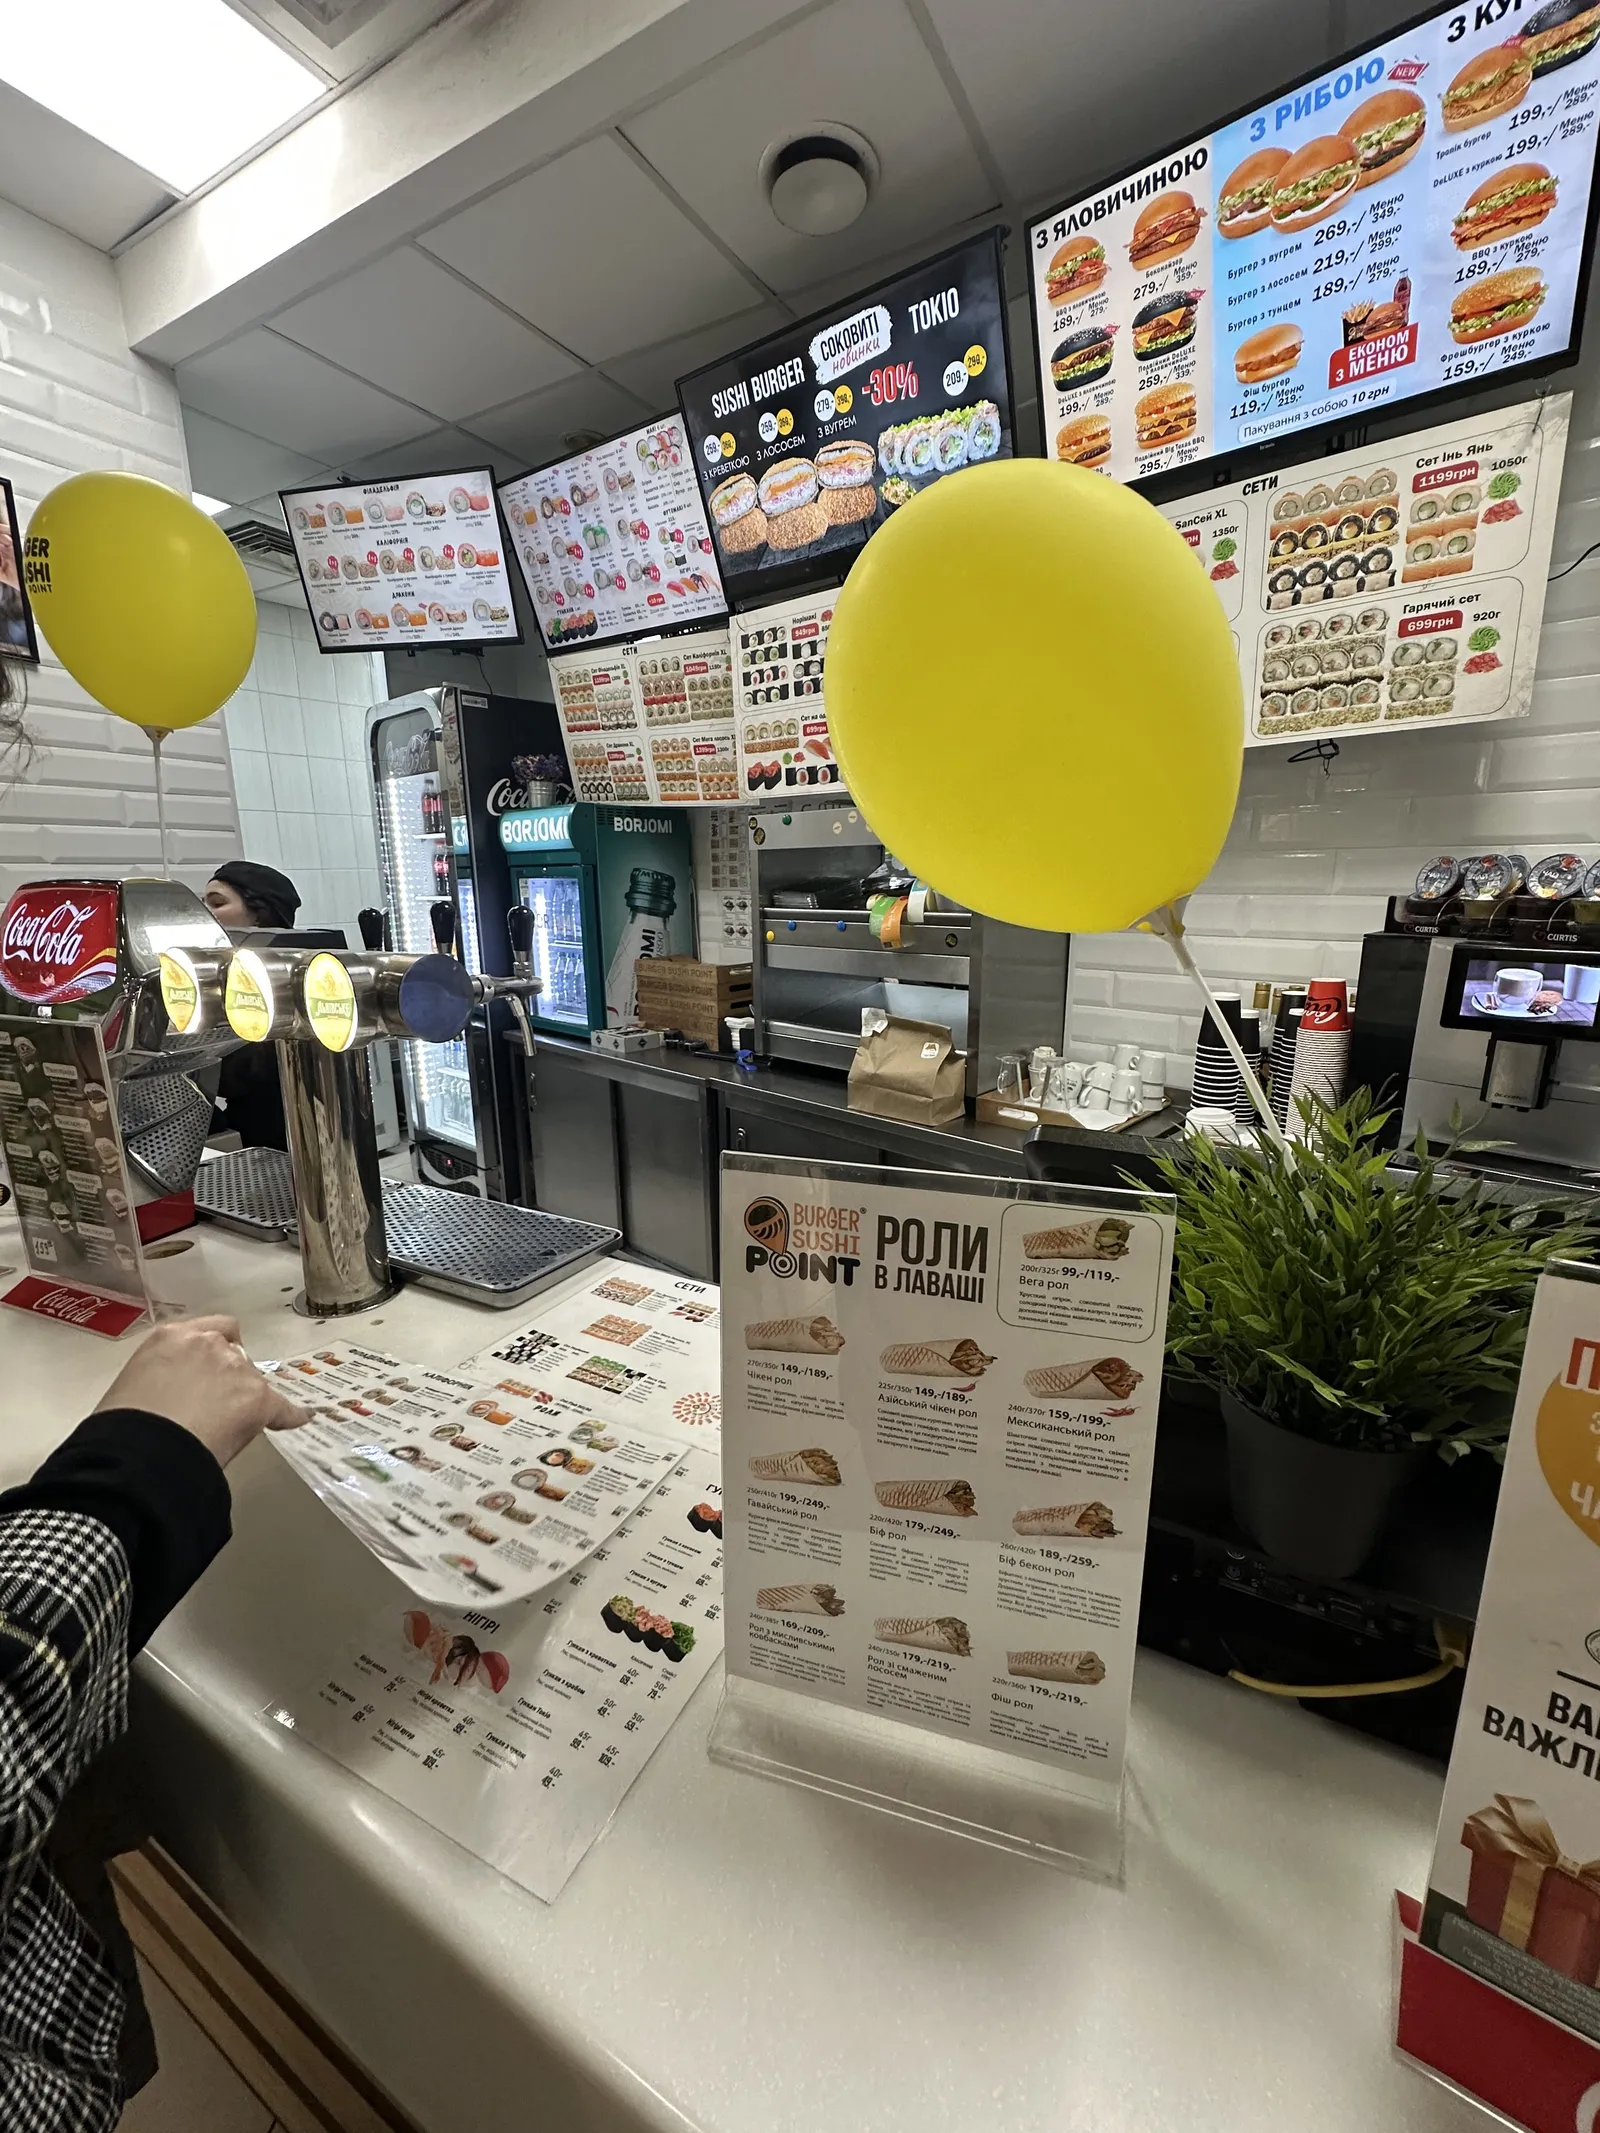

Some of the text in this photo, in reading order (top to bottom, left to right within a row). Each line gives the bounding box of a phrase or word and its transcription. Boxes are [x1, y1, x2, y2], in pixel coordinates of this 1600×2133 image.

[1394, 65, 1418, 79] NEW
[1250, 56, 1386, 142] З РИБОЮ
[1562, 79, 1599, 100] Меню
[1564, 91, 1595, 110] 289,-
[1558, 109, 1595, 132] Меню
[1463, 130, 1492, 149] бургер
[1560, 122, 1592, 140] 289,-
[1471, 151, 1503, 173] куркою
[1036, 147, 1208, 249] З ЯЛОВИЧИНОЮ
[1369, 192, 1405, 216] Меню
[1371, 206, 1401, 224] 349,-
[1367, 223, 1403, 246] Меню
[1369, 236, 1399, 254] 299,-
[1471, 232, 1534, 261] BBQ куркою
[1513, 235, 1549, 255] Меню
[1515, 247, 1546, 263] 279,-
[1227, 261, 1259, 280] Бургер
[1365, 254, 1401, 276] Меню
[1367, 267, 1397, 284] 279,-
[1227, 287, 1259, 307] Бургер
[1267, 266, 1309, 290] лососем
[907, 286, 960, 335] TOKIO
[1227, 297, 1302, 333] Бургер тунцем
[819, 311, 880, 362] СОКОВИТІ
[1348, 328, 1410, 362] ЕКОНОМ
[1440, 322, 1551, 363] Фрешбургер куркою
[1500, 338, 1536, 356] Меню
[1502, 350, 1532, 364] 249,-
[1349, 343, 1409, 379] МЕНЮ
[711, 356, 806, 419] SUSHI BURGER
[861, 360, 920, 407] -30%
[945, 369, 967, 387] 209,-
[1242, 376, 1291, 399] Фіш бургер
[1274, 383, 1305, 401] Меню
[1277, 394, 1303, 408] 219,-
[816, 397, 835, 413] 279,-
[1243, 384, 1391, 439] Пакування собою 10 грн
[824, 414, 858, 437] ВУГРЕМ
[763, 434, 807, 459] ЛОСОСЕМ
[1416, 442, 1494, 470] Сет Інь Янь
[709, 455, 750, 478] КРЕВЕТКОЮ
[1490, 455, 1529, 472] 1050г
[1242, 474, 1280, 496] СЕТИ
[1418, 464, 1477, 489] 1199грн
[1214, 508, 1228, 520] XL
[1212, 524, 1240, 539] 1350г
[1402, 592, 1482, 616] Гарячий сет
[1406, 616, 1455, 634] 699грн
[1472, 609, 1503, 623] 920г
[621, 646, 639, 657] СЕТИ
[501, 816, 570, 844] BORJOMI
[613, 816, 673, 834] BORJOMI
[1414, 925, 1440, 935] CURTIS
[1546, 932, 1579, 943] CURTIS
[791, 1202, 860, 1233] BURGER
[791, 1228, 861, 1256] SUSHI
[876, 1214, 989, 1274] РОЛИ
[745, 1244, 861, 1287] POINT
[673, 1281, 709, 1295] СЕТИ
[874, 1263, 985, 1304] В ЛАВАШІ
[1019, 1275, 1070, 1291] Вега рол
[747, 1369, 792, 1386] Чікен рол
[533, 1403, 563, 1418] РОЛИ
[877, 1393, 978, 1419] Азійський чікен рол
[1006, 1415, 1116, 1443] Мексиканський рол
[747, 1498, 819, 1522] Гавайський рол
[868, 1525, 908, 1542] Біф рол
[998, 1554, 1076, 1579] Біф бекон рол
[462, 1610, 501, 1634] НІГІРІ
[748, 1622, 835, 1653] Рол мисливськими
[748, 1631, 799, 1651] ковбасками
[626, 1667, 640, 1678] 40г
[867, 1654, 948, 1683] Рол смаженим
[867, 1663, 908, 1680] лососем
[653, 1680, 667, 1692] 50г
[603, 1697, 617, 1709] 50г
[991, 1692, 1034, 1711] Фіш рол
[631, 1712, 646, 1724] 50г
[578, 1730, 592, 1741] 45г
[605, 1744, 620, 1757] 45г
[548, 1766, 563, 1779] 40г
